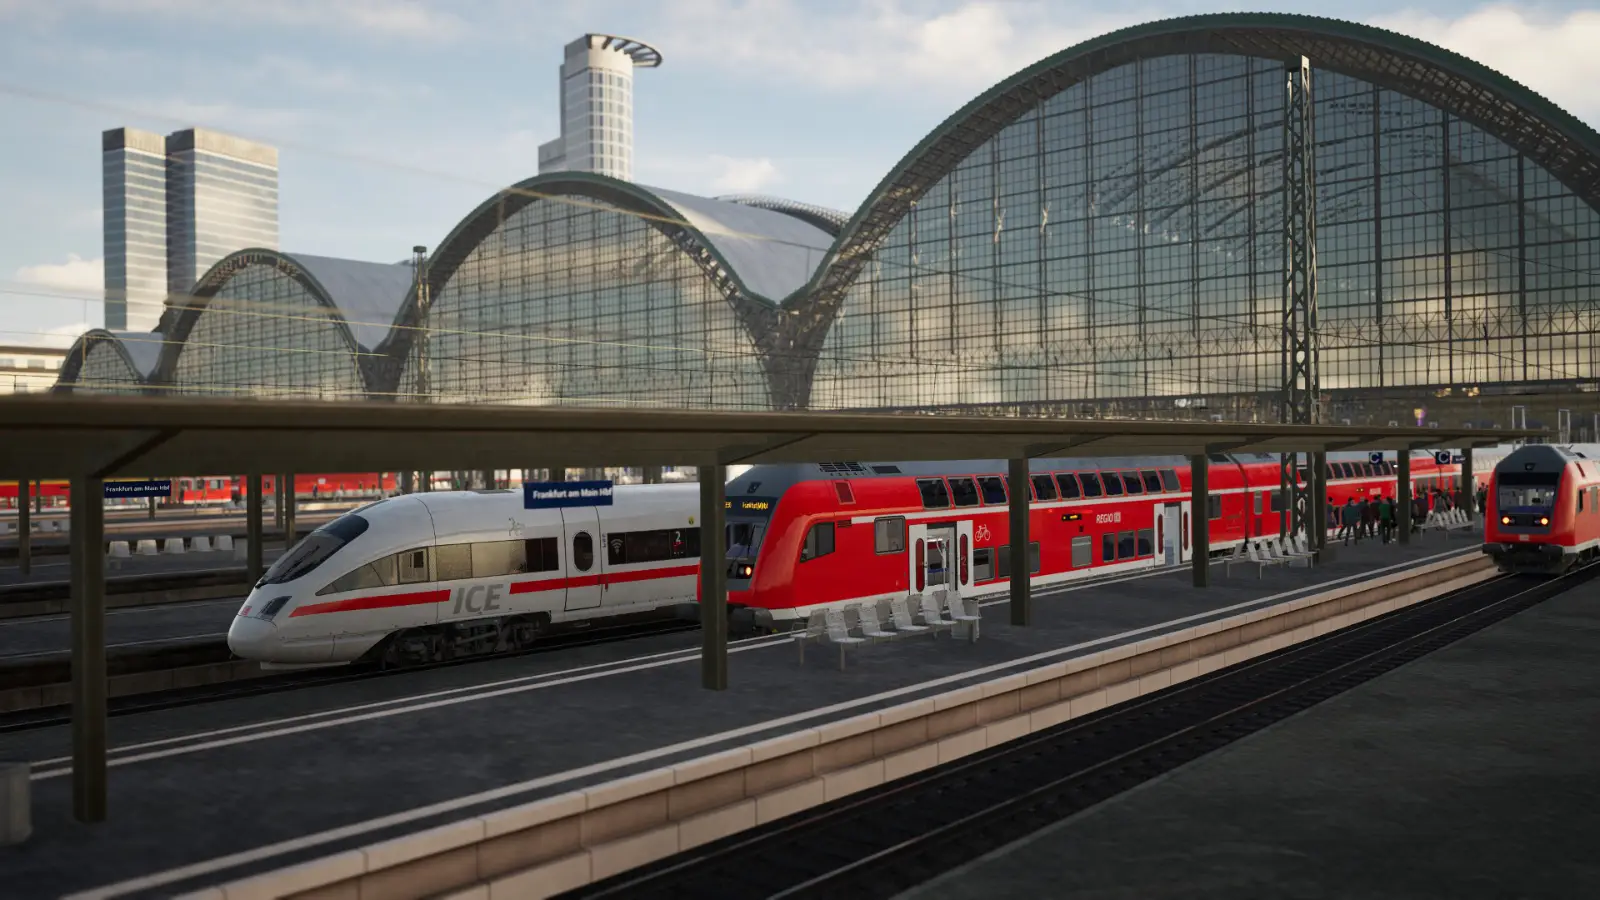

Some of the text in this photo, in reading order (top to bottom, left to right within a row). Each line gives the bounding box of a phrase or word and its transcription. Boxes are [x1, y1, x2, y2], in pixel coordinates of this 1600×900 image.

[1369, 452, 1380, 464] C
[1438, 451, 1449, 464] C
[105, 485, 133, 493] Frankfurt
[532, 487, 612, 499] Frankfurt am Main Hbf
[1095, 513, 1114, 524] REGIO
[675, 531, 681, 542] 2
[453, 584, 504, 615] ICE
